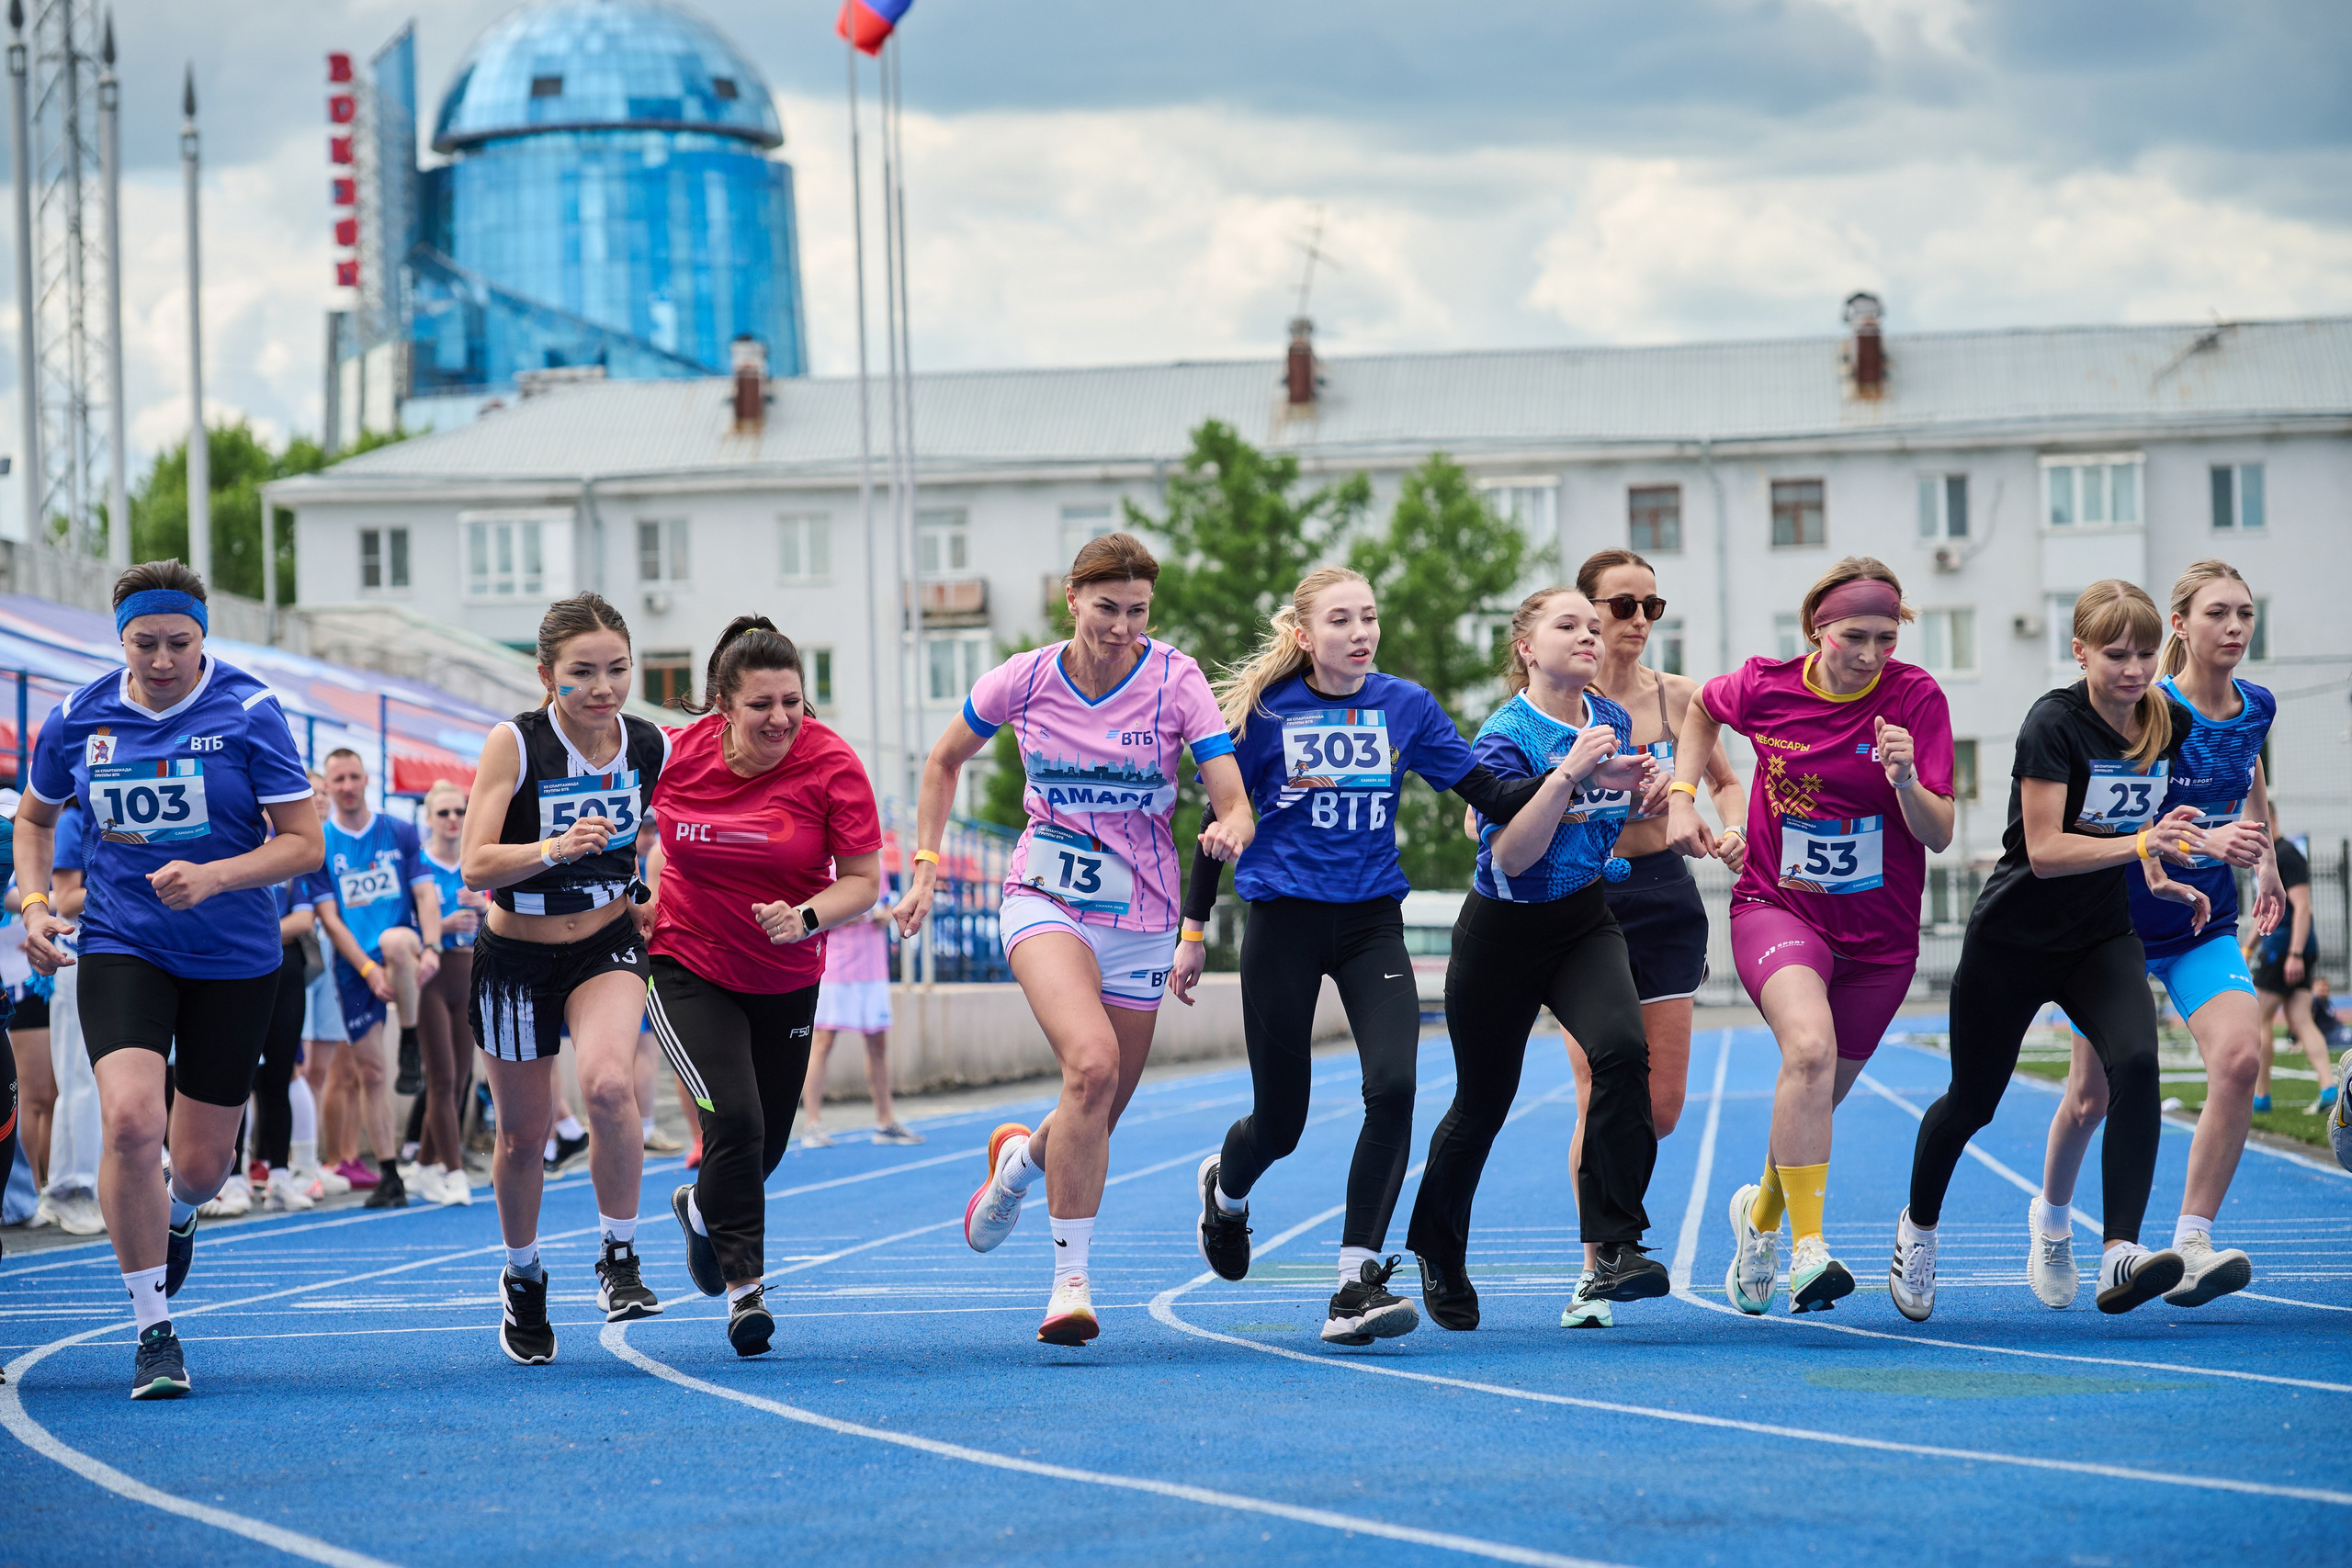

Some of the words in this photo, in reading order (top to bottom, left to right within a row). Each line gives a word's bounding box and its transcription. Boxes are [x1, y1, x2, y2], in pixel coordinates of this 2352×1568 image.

[190, 735, 224, 751] ВТБ
[1121, 730, 1154, 746] ВТБ
[1294, 732, 1381, 769] 303
[1755, 733, 1811, 752] ЧЕБОКСАРЫ
[103, 784, 190, 825] 103
[1311, 791, 1395, 830] ВТБ
[2107, 783, 2152, 818] 23
[676, 822, 711, 842] РГС
[1058, 851, 1102, 894] 13
[1804, 839, 1859, 876] 53
[348, 874, 392, 897] 202
